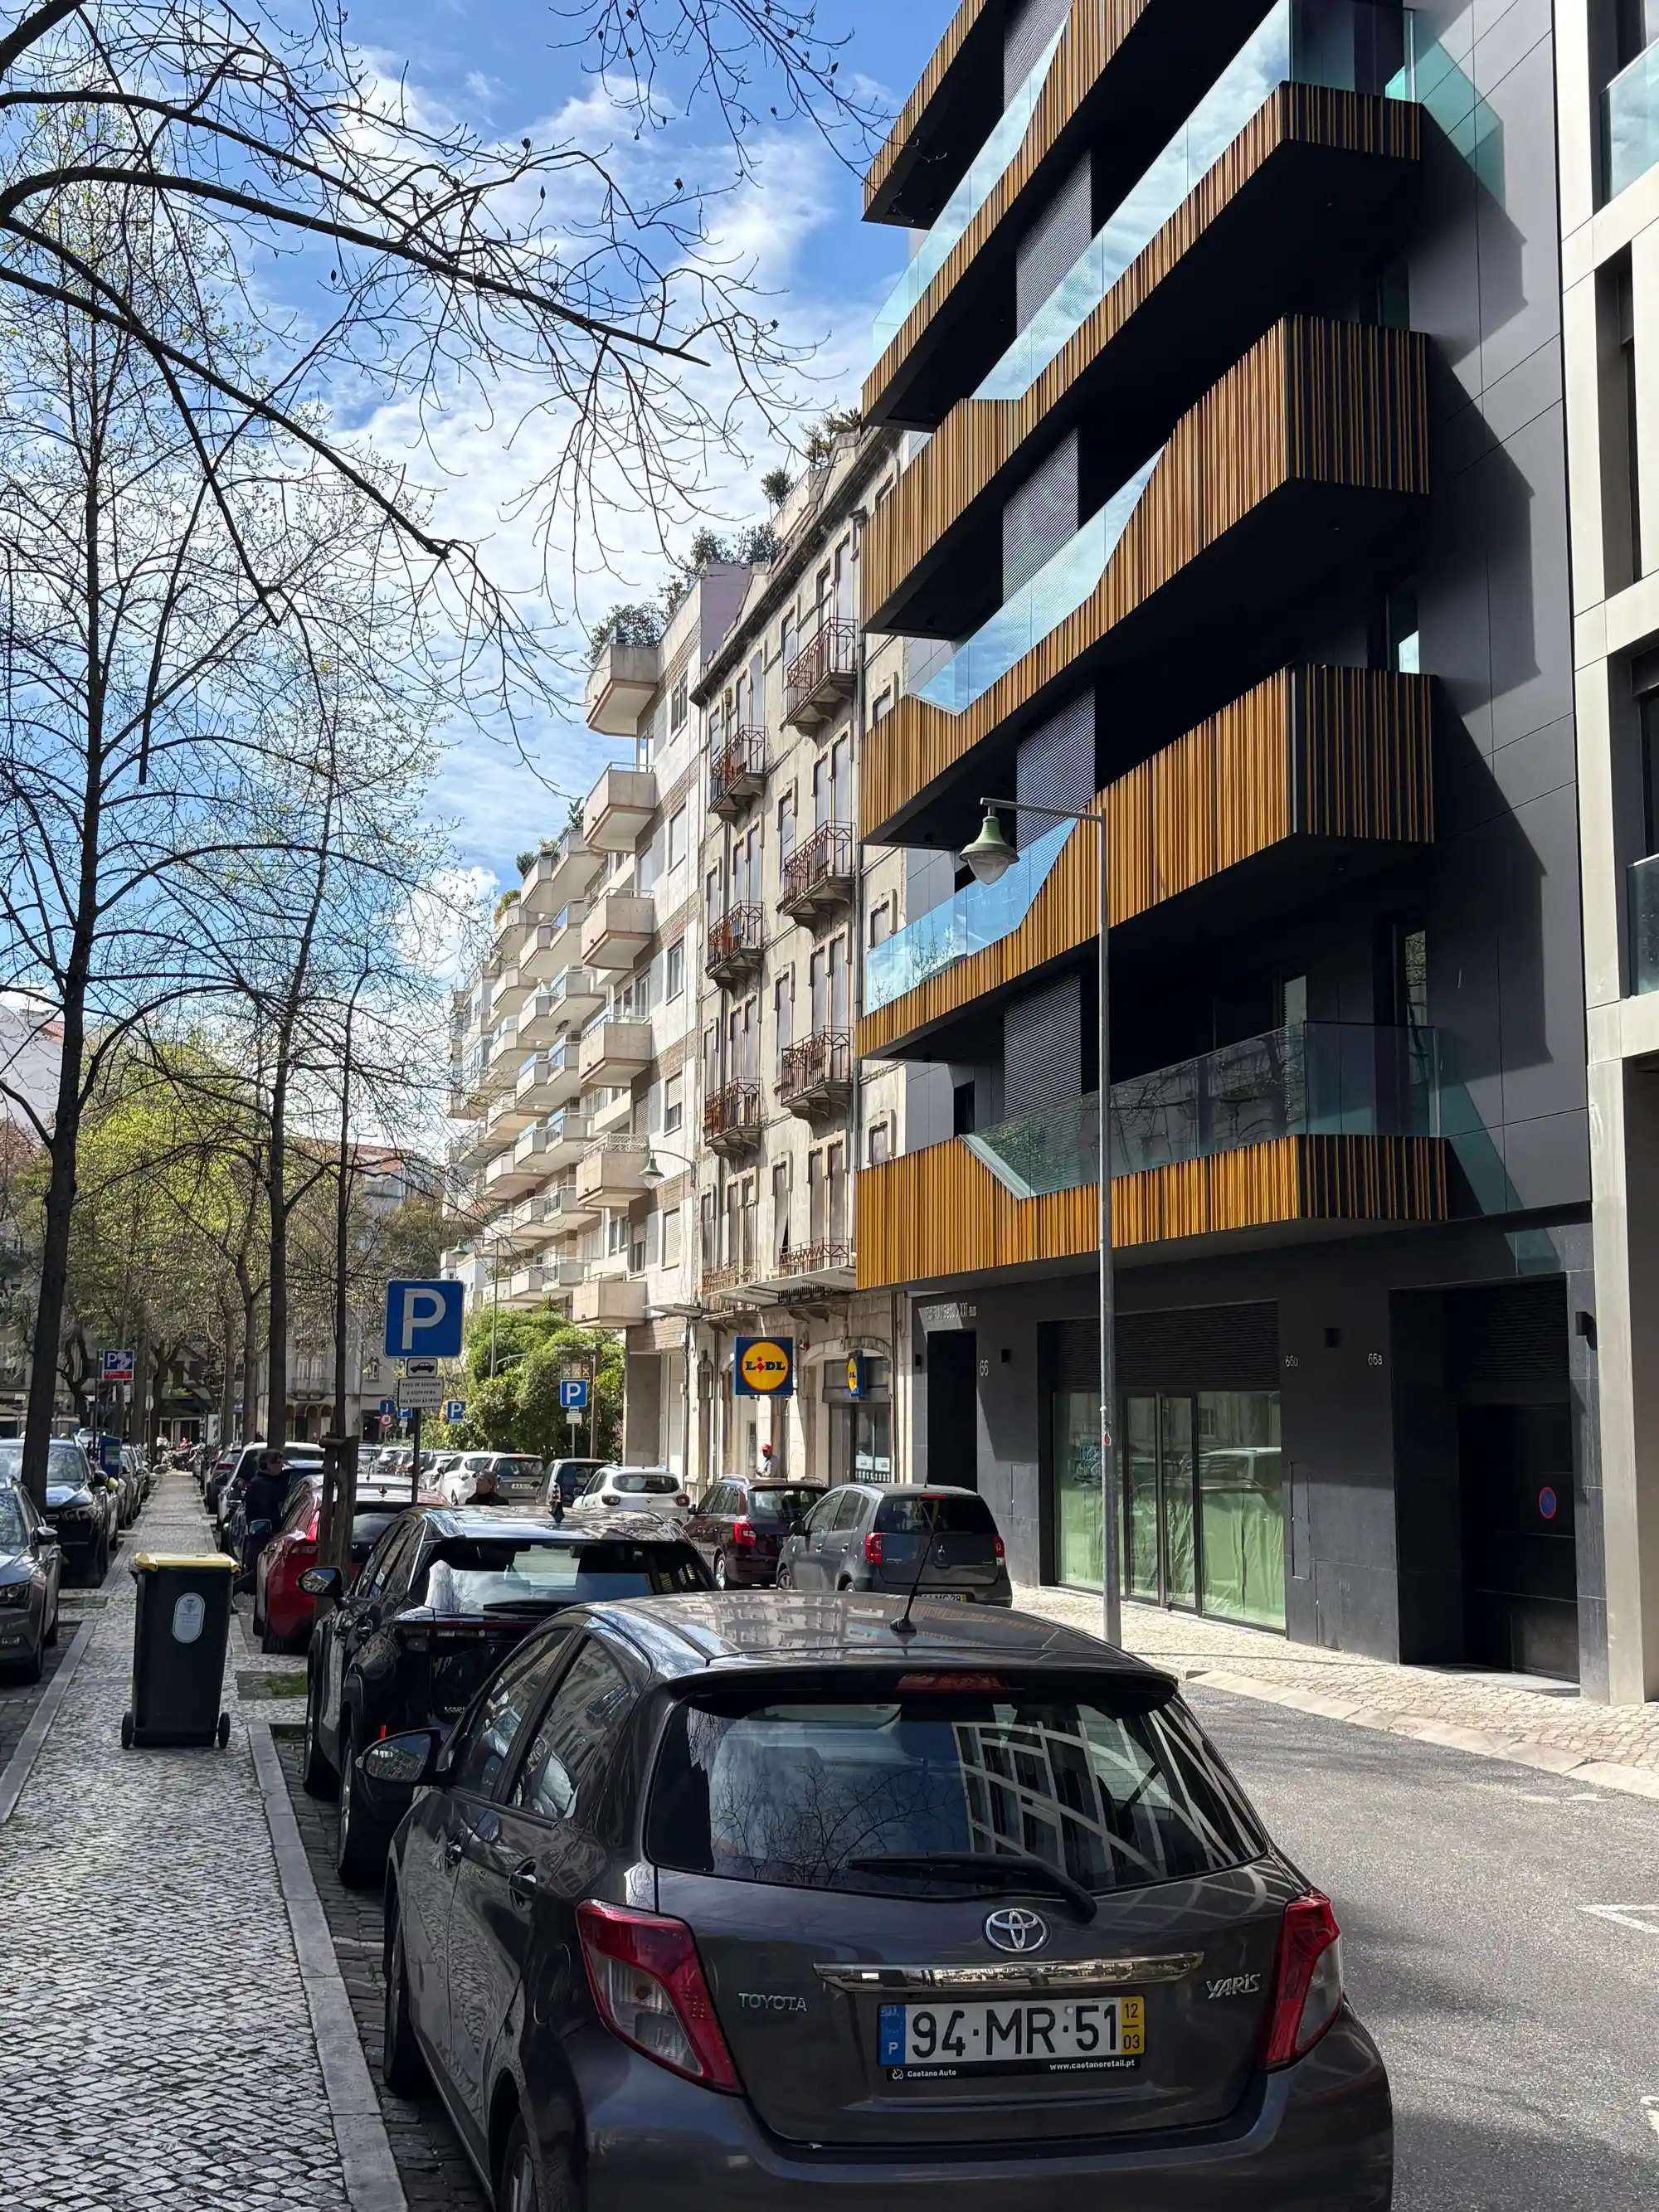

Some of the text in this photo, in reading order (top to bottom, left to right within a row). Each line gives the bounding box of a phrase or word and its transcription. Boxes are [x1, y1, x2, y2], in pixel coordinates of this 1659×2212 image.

[401, 1288, 446, 1349] P
[107, 1353, 117, 1368] P
[980, 1359, 989, 1376] 66
[567, 1383, 581, 1404] P
[450, 1403, 462, 1417] P
[444, 1706, 466, 1714] YARI
[738, 1993, 807, 2011] TOYOTA
[1125, 2003, 1139, 2019] 12
[888, 2041, 898, 2055] P
[1123, 2034, 1140, 2049] 03
